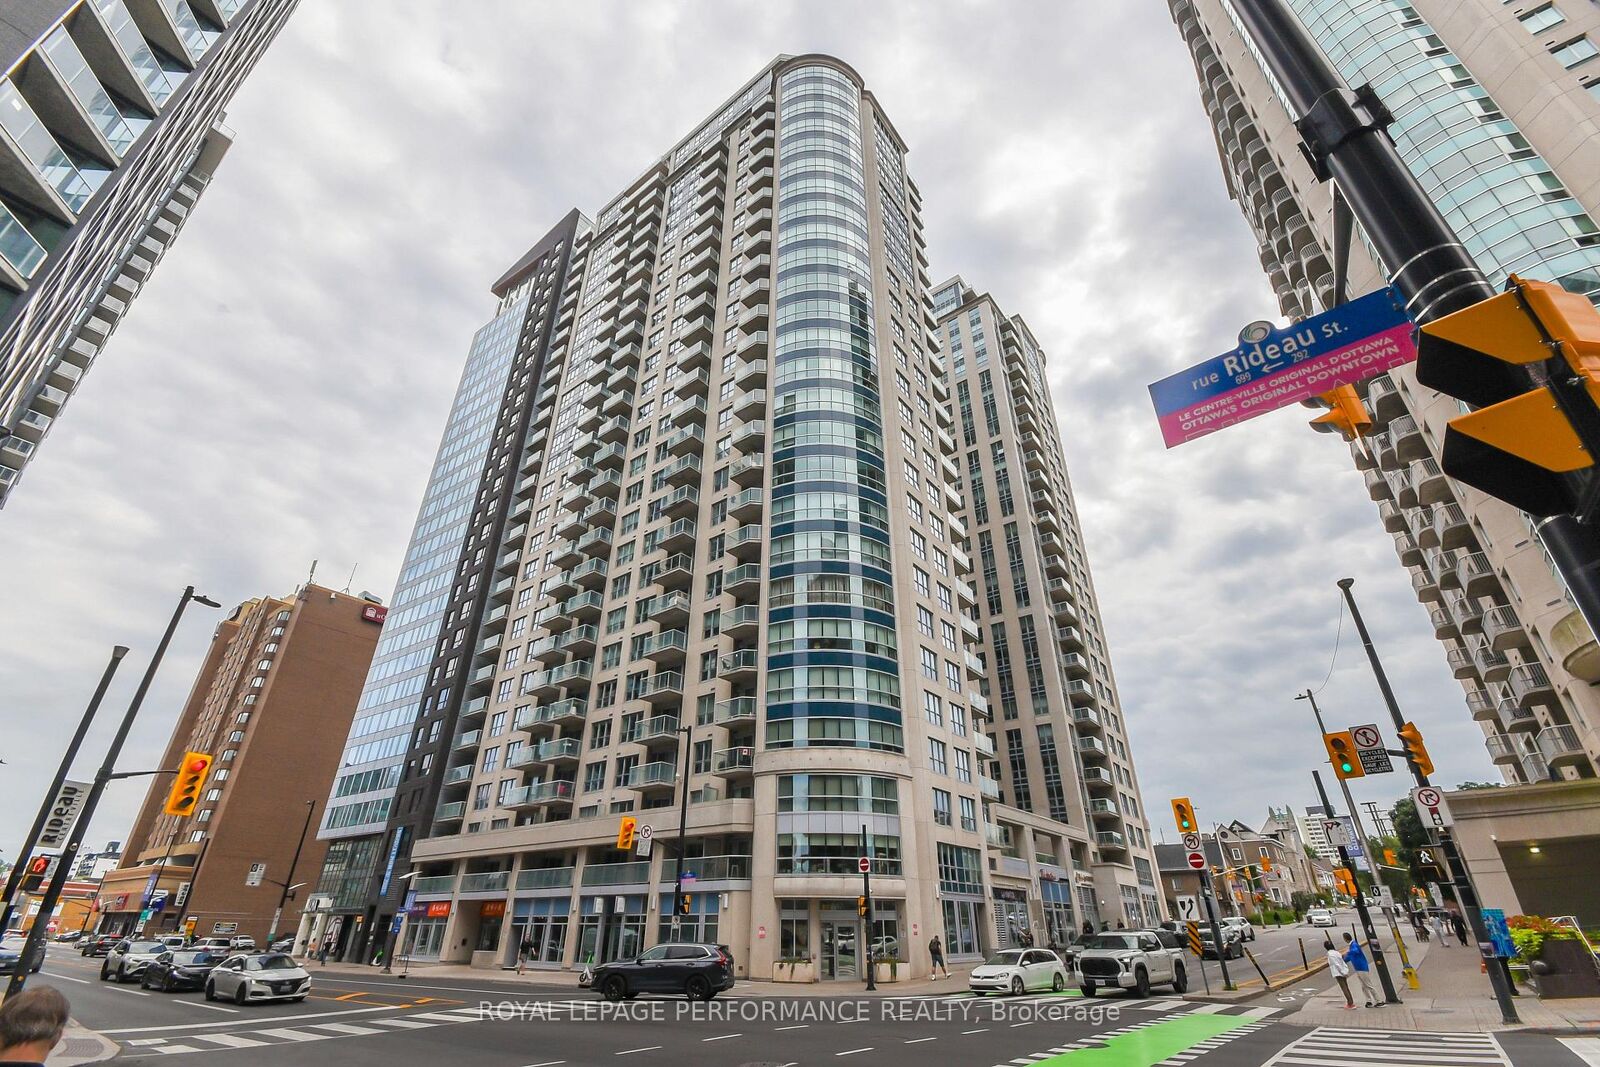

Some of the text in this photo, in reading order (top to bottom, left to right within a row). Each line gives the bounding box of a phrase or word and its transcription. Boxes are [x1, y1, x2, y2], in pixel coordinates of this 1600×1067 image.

[1178, 336, 1394, 422] LE CENTRE-VILLE ORIGINAL D'OTTAWA
[1181, 344, 1400, 431] OTTAWA'S ORIGINAL DOWNTOWN
[1191, 320, 1349, 391] rue Rideau St.
[1235, 349, 1310, 385] 699 292
